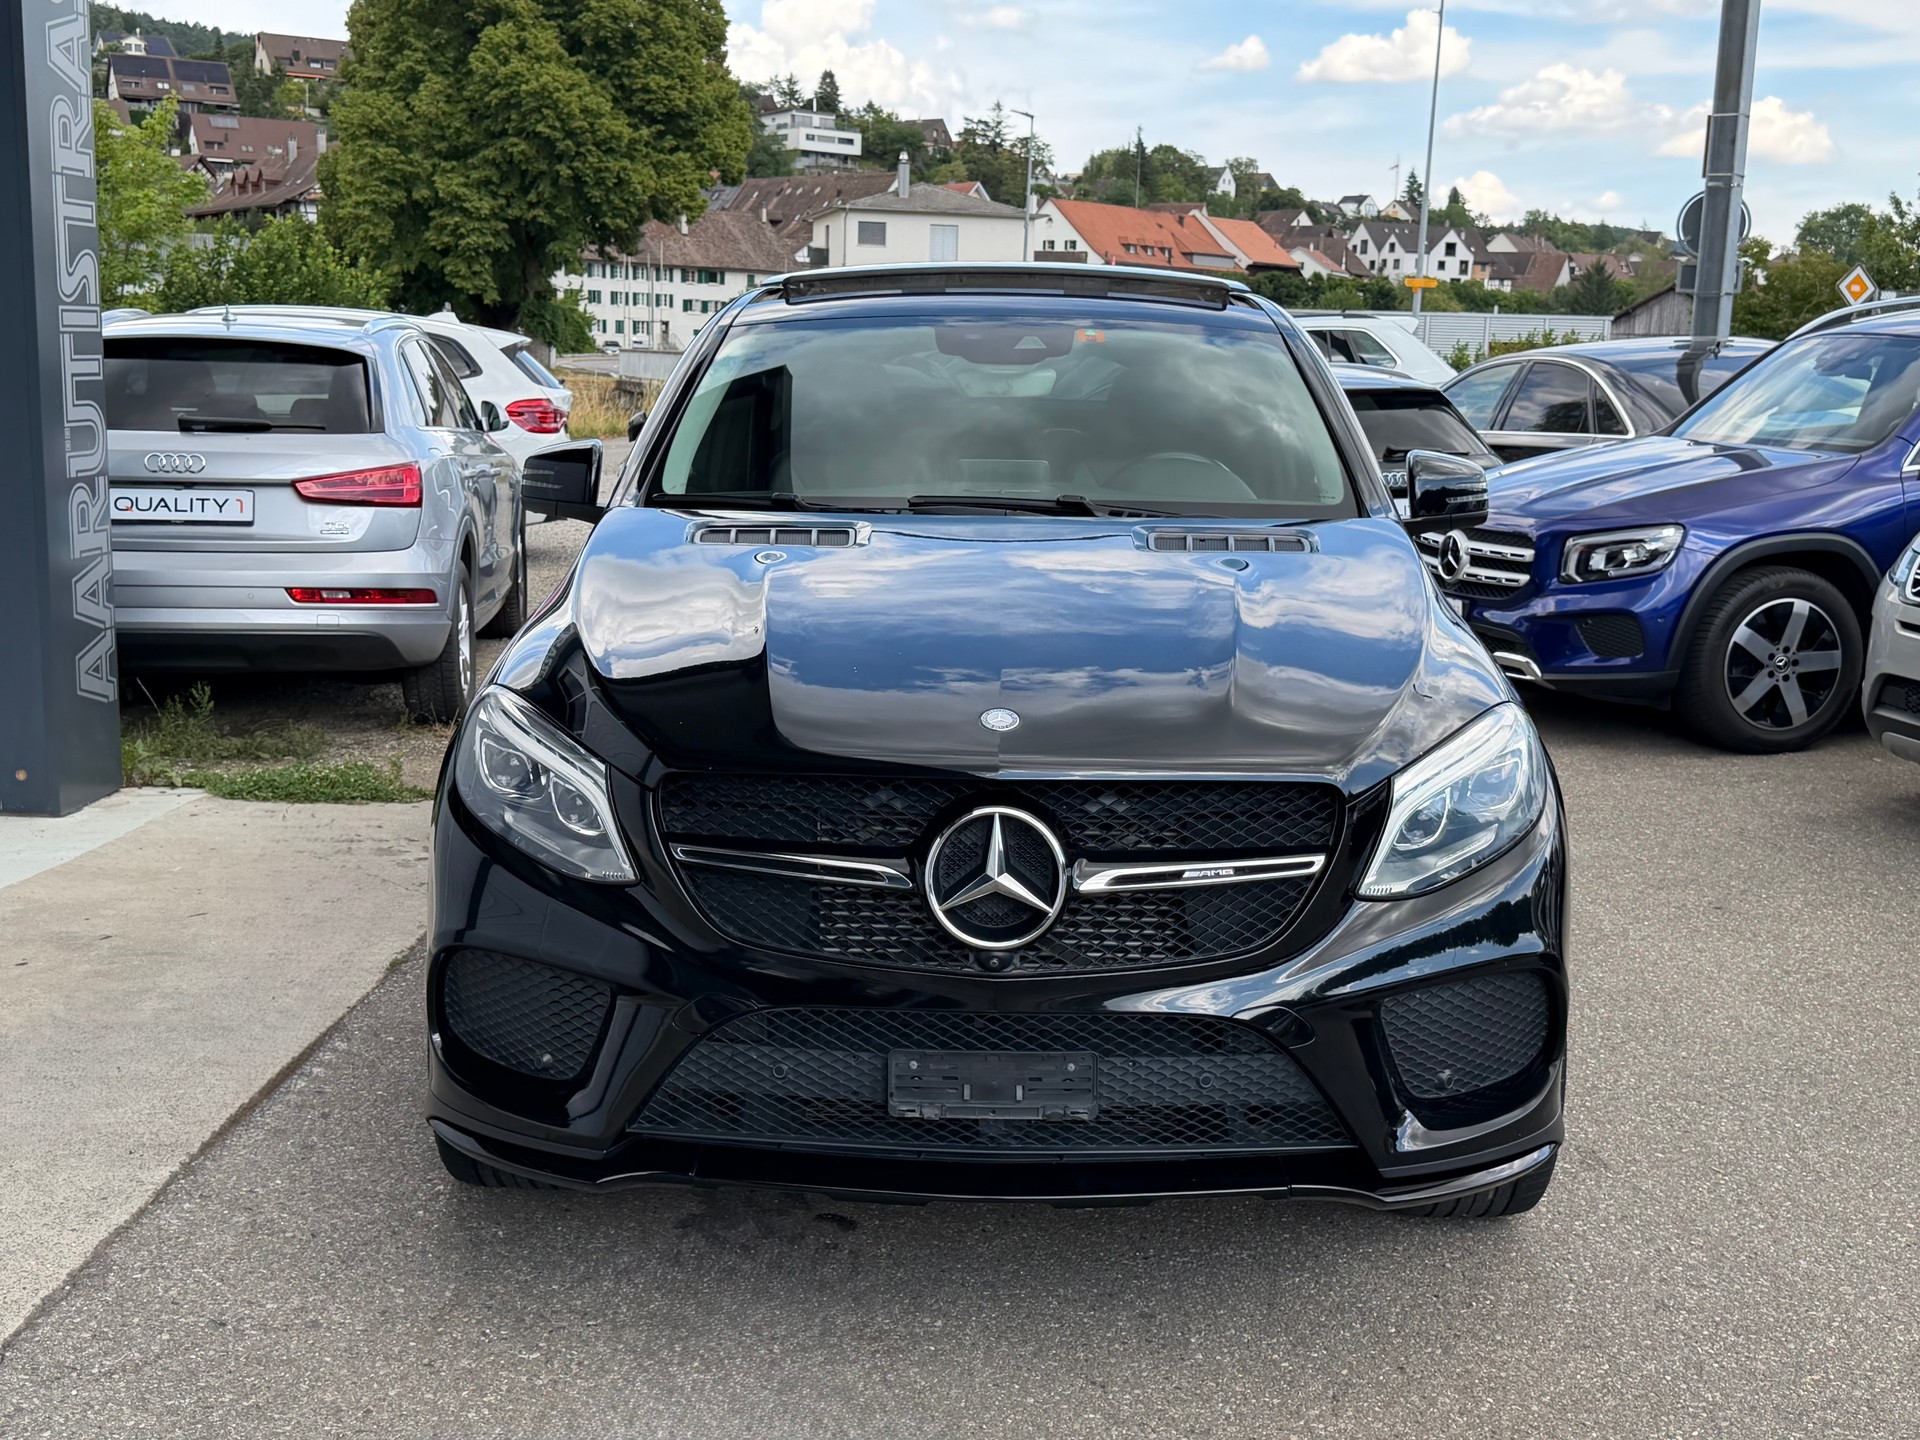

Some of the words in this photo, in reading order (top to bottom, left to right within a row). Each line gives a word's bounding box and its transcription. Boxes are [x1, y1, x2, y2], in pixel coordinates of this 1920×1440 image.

[45, 0, 117, 703] AARÜTISTRA
[114, 497, 229, 513] QUALITY
[235, 498, 244, 514] 1
